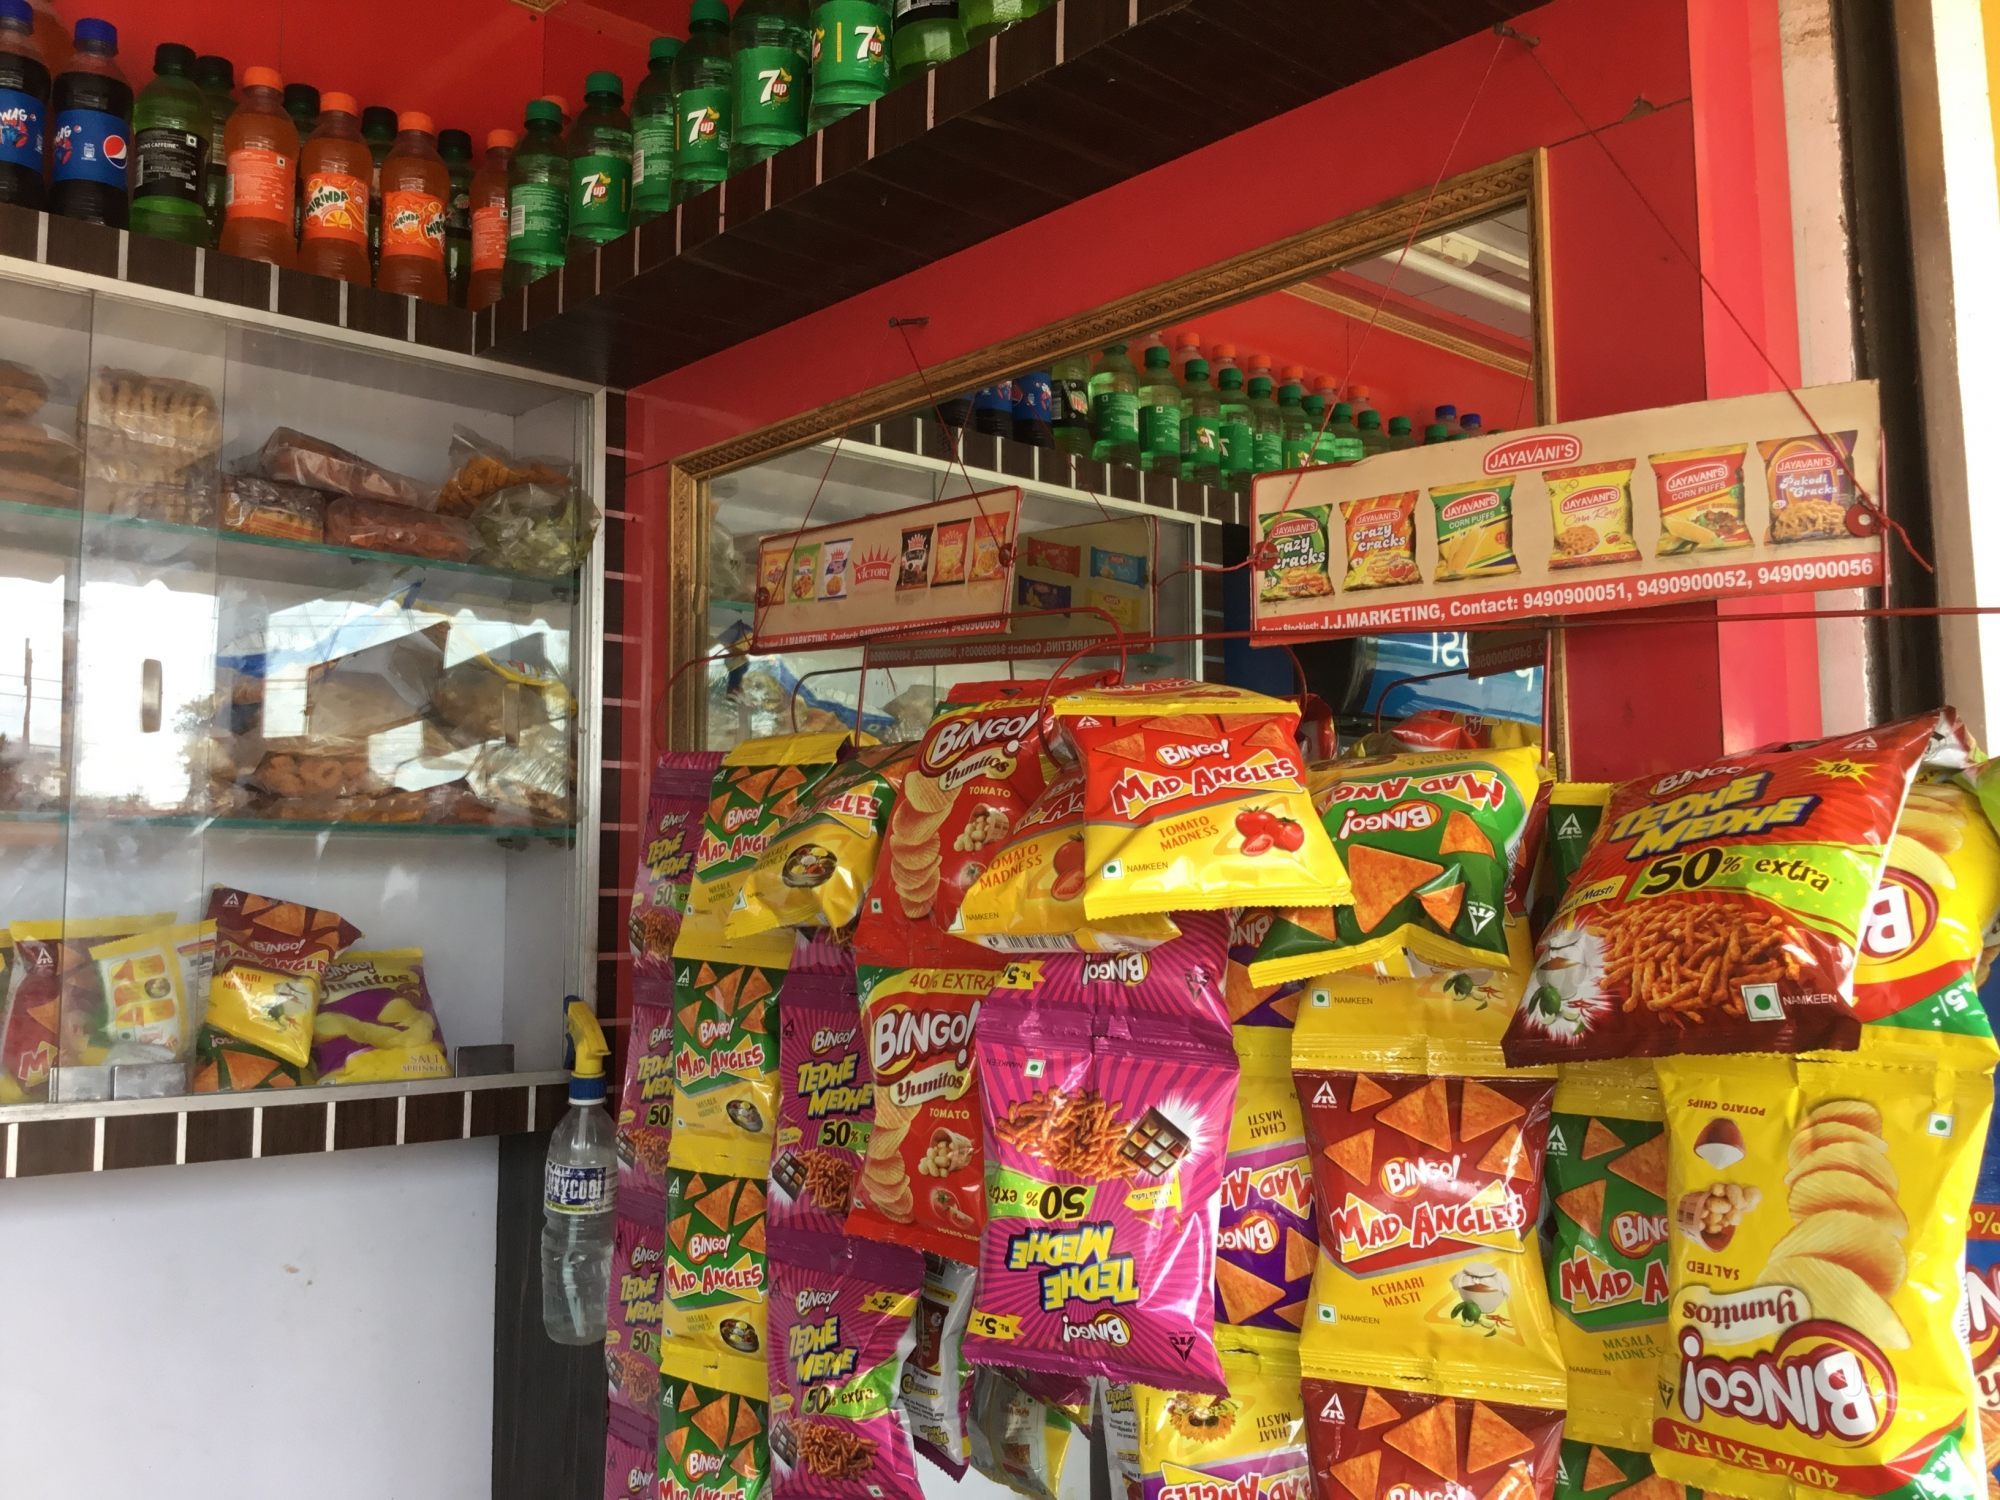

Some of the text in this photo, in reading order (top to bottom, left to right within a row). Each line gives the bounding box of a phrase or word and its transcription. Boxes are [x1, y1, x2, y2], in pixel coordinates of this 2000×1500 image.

[0, 108, 28, 122] WAG
[305, 187, 349, 216] MIRINDA
[1490, 442, 1574, 470] JAYAVANI'S
[1779, 456, 1833, 471] JAYAVANI'S
[1670, 467, 1725, 489] JAYAVANI'S
[1780, 473, 1827, 489] Pakodi
[1564, 490, 1617, 511] JAYAVANI'S
[1671, 481, 1726, 501] CORN PUFFS
[1790, 484, 1838, 499] Cracks
[1444, 494, 1498, 517] JAYAVANI'S
[1274, 521, 1316, 536] JAYAVANI'S
[1356, 510, 1399, 525] JAYAVANI'S
[1449, 511, 1495, 529] CORN PUFFS
[1352, 524, 1392, 542] crazy
[1358, 534, 1406, 552] cracks
[1276, 537, 1310, 553] razy
[1273, 549, 1326, 570] cracks
[857, 567, 890, 580] VICTORY
[1450, 595, 1518, 617] Contact:
[1758, 558, 1873, 584] 9490900056
[929, 708, 1040, 765] BINGO!
[1159, 739, 1230, 766] BINGO!
[944, 751, 1010, 788] Yumitos
[969, 785, 1011, 798] TOMATO
[1111, 773, 1184, 815] MAD
[1192, 757, 1299, 797] ANGLES
[1331, 772, 1507, 812] MAD ANG
[726, 804, 763, 830] BINGO!
[1608, 771, 1772, 843] TEDHE
[1158, 815, 1210, 839] TOMATO
[1338, 804, 1432, 841] BINGO!
[1625, 794, 1820, 861] MEDHE
[647, 832, 685, 865] TEDHE
[697, 833, 773, 865] MAD ANGL
[1160, 825, 1220, 852] MADNESS
[979, 853, 1043, 890] MADNESS
[1126, 861, 1169, 873] NAMKEEN
[1639, 847, 1831, 896] 50% extra
[1583, 884, 1615, 902] Masti
[966, 912, 1000, 921] NAMKEEN
[254, 938, 306, 954] BINGO!
[260, 957, 328, 974] ANGLE
[1082, 952, 1145, 986] BINGO!
[942, 972, 996, 991] EXTRA
[1333, 996, 1374, 1006] NAMKEEN
[1782, 992, 1838, 1007] NAMKEEN
[699, 1018, 735, 1042] BINGO!
[813, 1027, 857, 1050] BINGO!
[875, 1000, 982, 1070] BINGO!
[410, 1054, 440, 1064] SALT
[676, 1043, 765, 1080] MAD ANGLES
[797, 1053, 861, 1094] TEDHE
[896, 1071, 965, 1105] Yumitos
[807, 1083, 874, 1119] MEDHE
[1686, 1098, 1766, 1117] POTATO CHIPS
[929, 1107, 970, 1120] TOMATO
[1248, 1109, 1283, 1125] MASTI
[1249, 1121, 1287, 1139] CHAAT
[1384, 1155, 1461, 1196] BINGO!
[1025, 1184, 1088, 1220] 50%
[1330, 1193, 1527, 1252] MAD ANGLES
[632, 1245, 663, 1267] BINGO!
[690, 1235, 731, 1258] BINGO!
[1008, 1226, 1116, 1270] MEDHE
[665, 1263, 763, 1295] MAD ANGLES
[1559, 1254, 1634, 1304] MAD
[1686, 1259, 1740, 1281] SALTED
[620, 1271, 660, 1301] TEDHE
[1044, 1257, 1141, 1311] TEDHE
[1371, 1276, 1425, 1297] ACHAARI
[797, 1290, 837, 1314] BINGO!
[1383, 1292, 1422, 1308] MASTI
[1682, 1288, 1800, 1331] Yumitos
[1062, 1315, 1131, 1346] BINGO!
[1340, 1313, 1380, 1325] NAMKEEN
[789, 1317, 840, 1354] TEDHE
[1603, 1334, 1655, 1349] MASALA
[797, 1349, 858, 1384] MEDHE
[1568, 1366, 1612, 1377] NAMKEEN
[841, 1386, 874, 1403] extra
[1681, 1334, 1878, 1437] BINGO!
[1256, 1412, 1291, 1428] MASTI
[689, 1452, 725, 1476] BINGO!
[1671, 1425, 1840, 1490] 40% EXTRA
